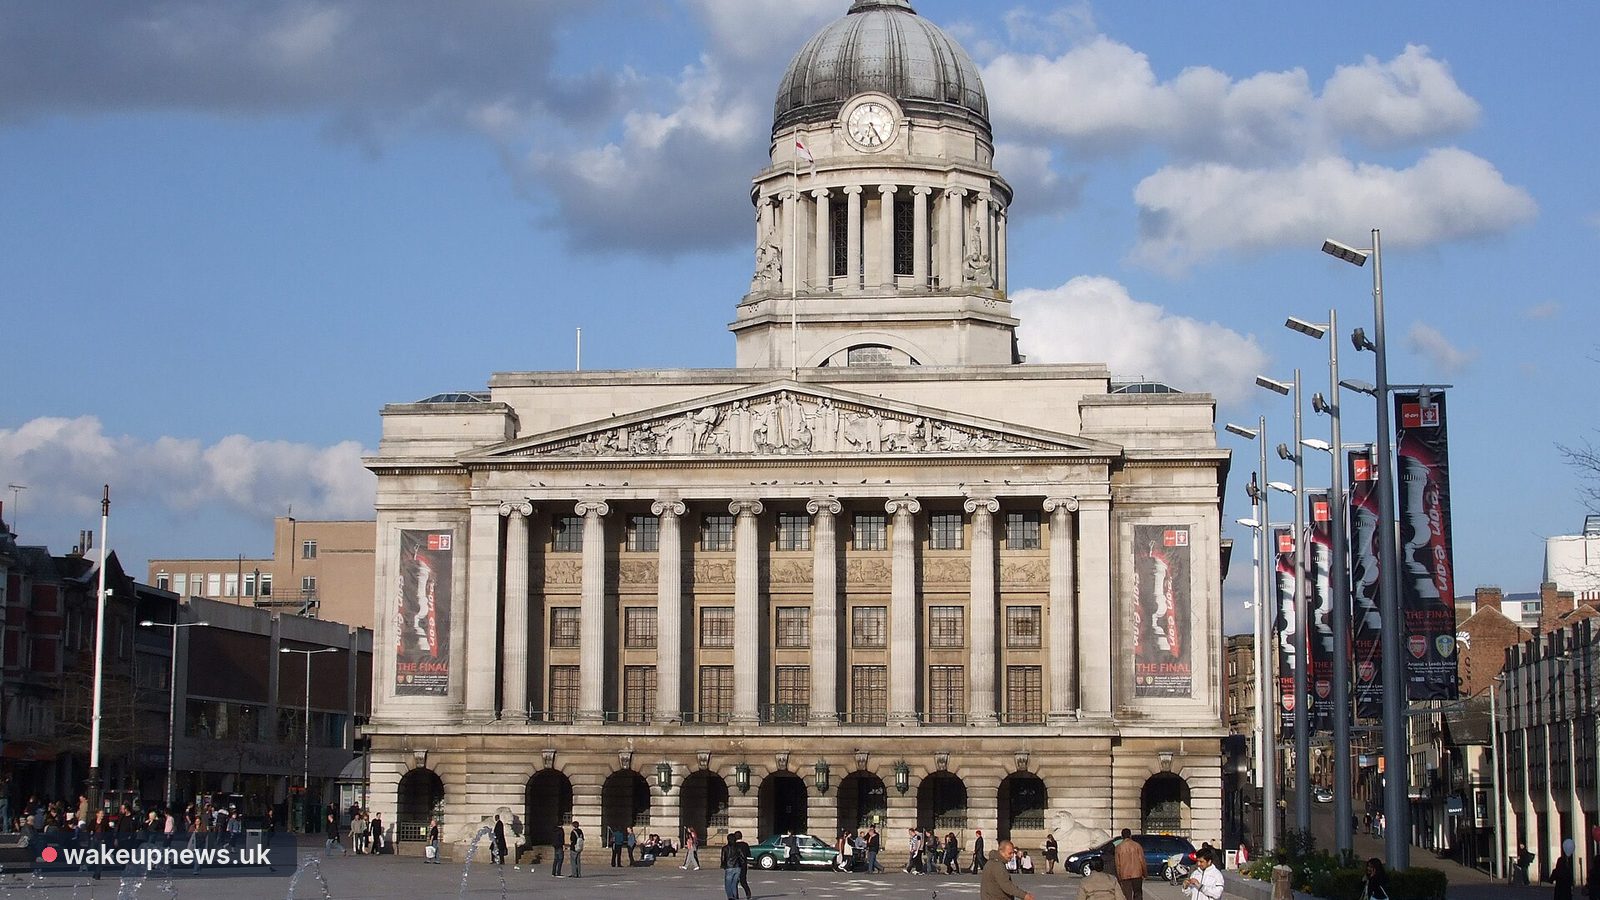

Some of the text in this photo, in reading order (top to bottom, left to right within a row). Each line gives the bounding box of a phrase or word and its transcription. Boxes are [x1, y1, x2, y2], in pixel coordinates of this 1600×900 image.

[1405, 610, 1455, 619] THE FINAL
[397, 662, 449, 672] THE FINAL
[1136, 663, 1190, 672] THE FINAL
